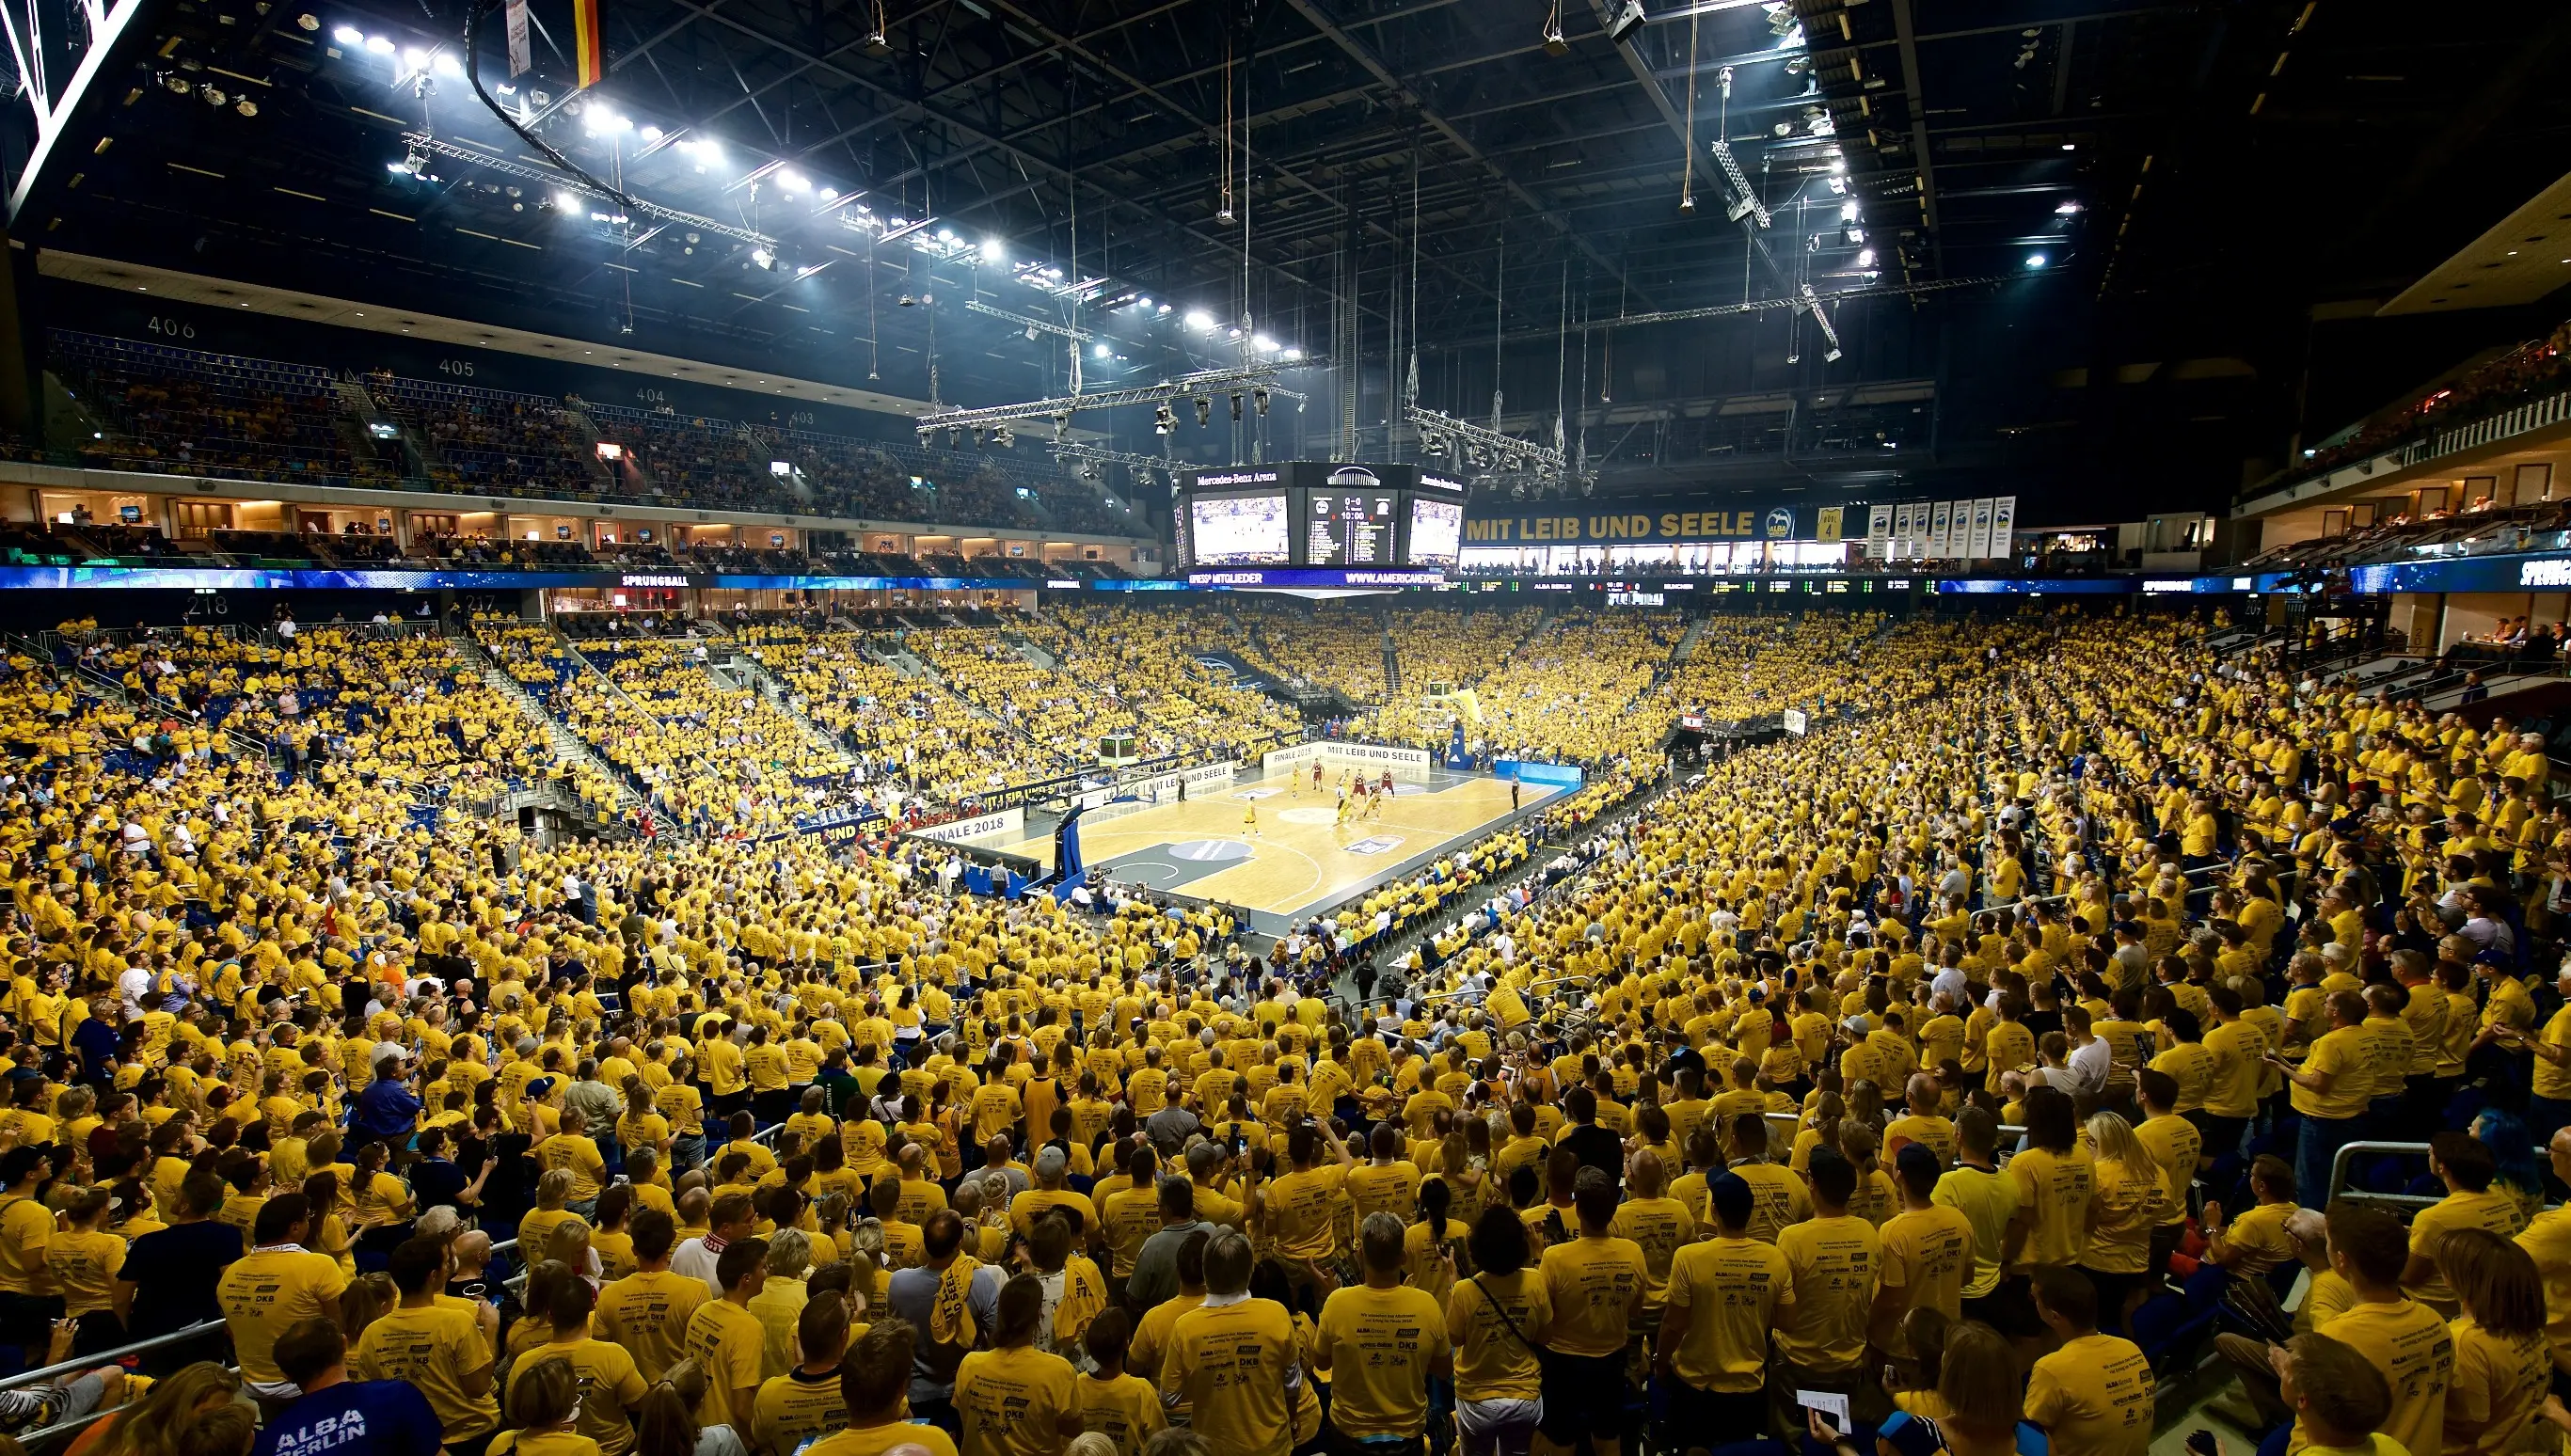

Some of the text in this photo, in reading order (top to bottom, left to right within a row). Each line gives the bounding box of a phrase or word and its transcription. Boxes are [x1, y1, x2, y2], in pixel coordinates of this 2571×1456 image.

[148, 316, 196, 340] 406
[439, 359, 474, 376] 405
[636, 388, 665, 403] 404
[791, 411, 814, 425] 403
[1197, 472, 1277, 485] Mercedes-Benz Arena
[1341, 512, 1365, 520] 10:00
[1467, 511, 1754, 541] MIT LEIB UND SEELE
[1826, 524, 1832, 537] 4
[623, 576, 689, 586] SPRUNGBALL
[1212, 573, 1262, 584] MITGLIEDER
[187, 595, 228, 614] 218
[1327, 746, 1422, 763] MIT LEIB UND SEELE
[1185, 772, 1202, 783] UND
[1204, 767, 1227, 780] SEELE
[974, 816, 1005, 834] 2018
[832, 944, 842, 956] 33
[969, 1031, 976, 1044] 3
[1853, 1264, 1868, 1273] DKB
[1751, 1284, 1768, 1292] DKB
[1398, 1341, 1418, 1350] DKB
[1239, 1357, 1259, 1366] DKB
[2105, 1381, 2119, 1389] ALBA
[1005, 1410, 1024, 1419] DKB
[277, 1409, 365, 1453] ALBA
